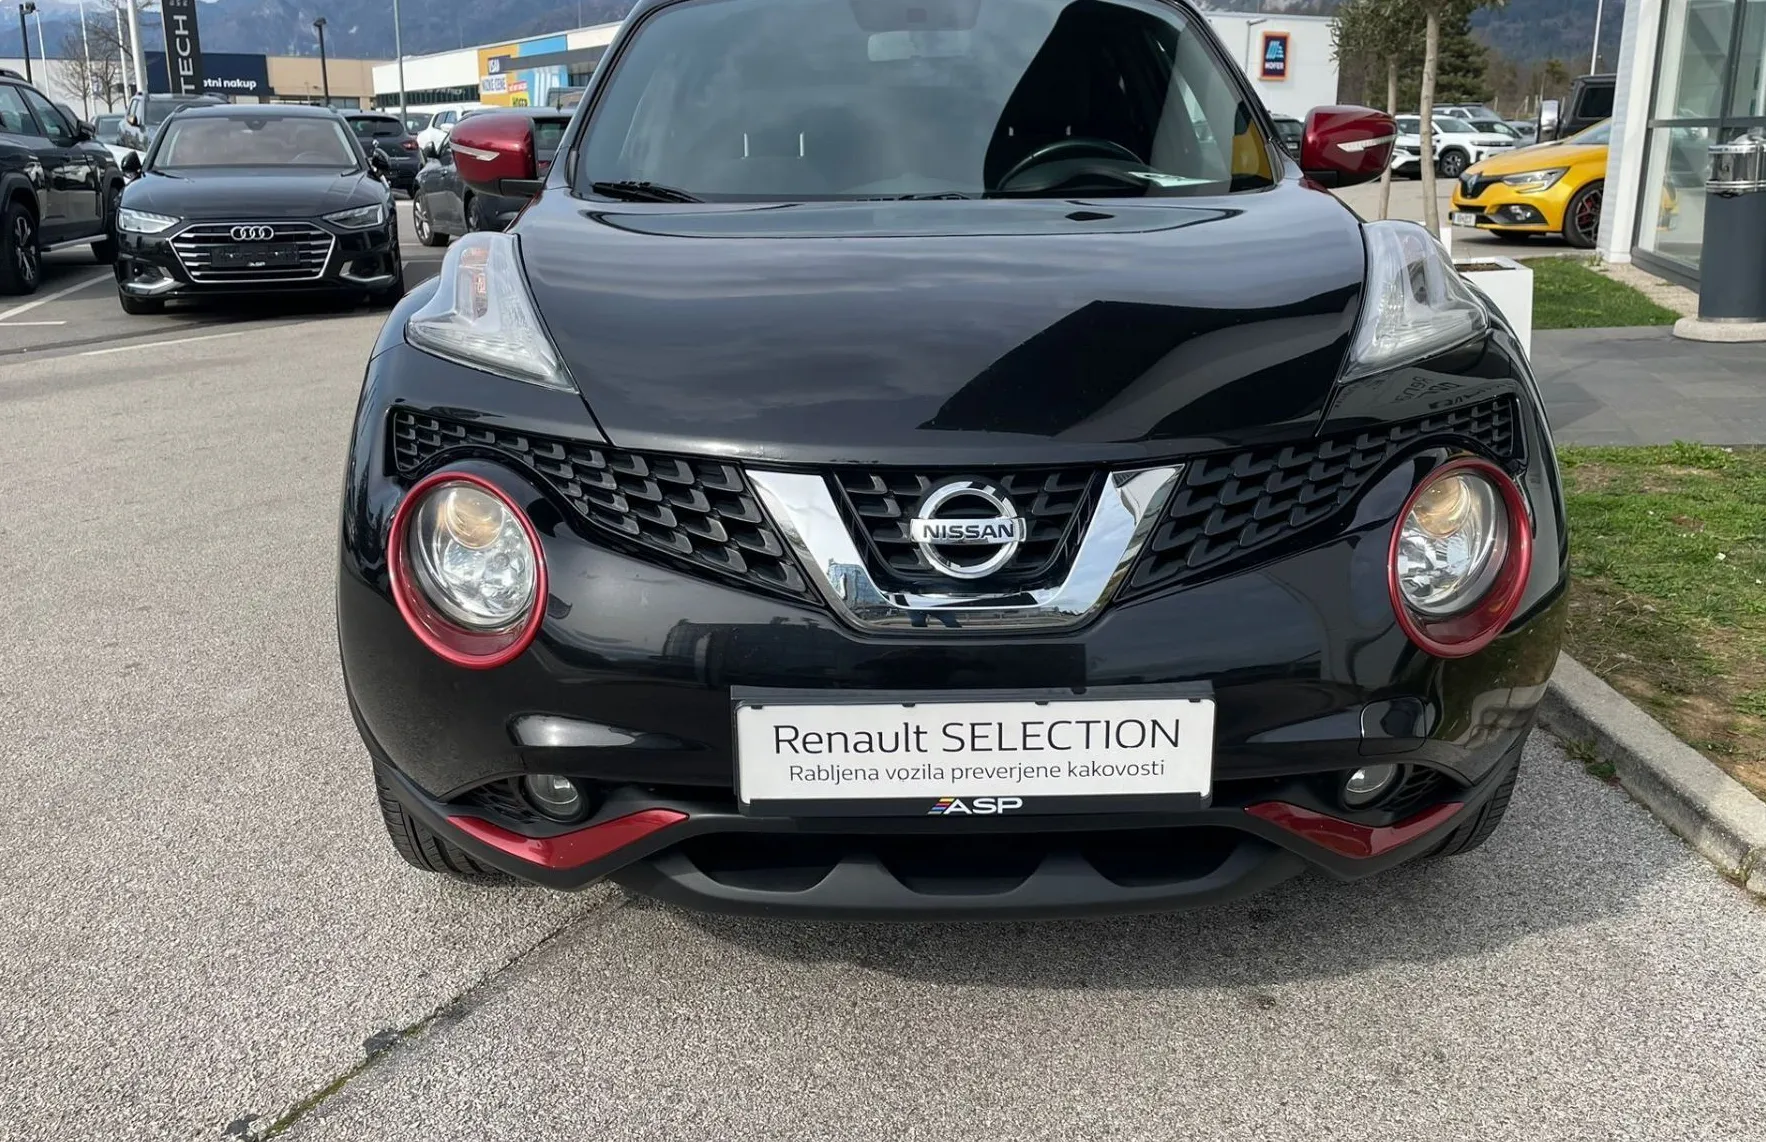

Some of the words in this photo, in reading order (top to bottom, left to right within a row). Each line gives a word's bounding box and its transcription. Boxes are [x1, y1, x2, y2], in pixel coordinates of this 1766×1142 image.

[173, 15, 195, 95] TECH
[923, 523, 1014, 539] NISSAN
[773, 722, 929, 754] Renault
[942, 719, 1181, 753] SELECTION
[789, 763, 880, 784] Rabljena
[885, 762, 944, 781] vozila
[950, 761, 1062, 784] preverjene
[1067, 759, 1164, 779] kakovosti
[942, 797, 1024, 814] ASP
